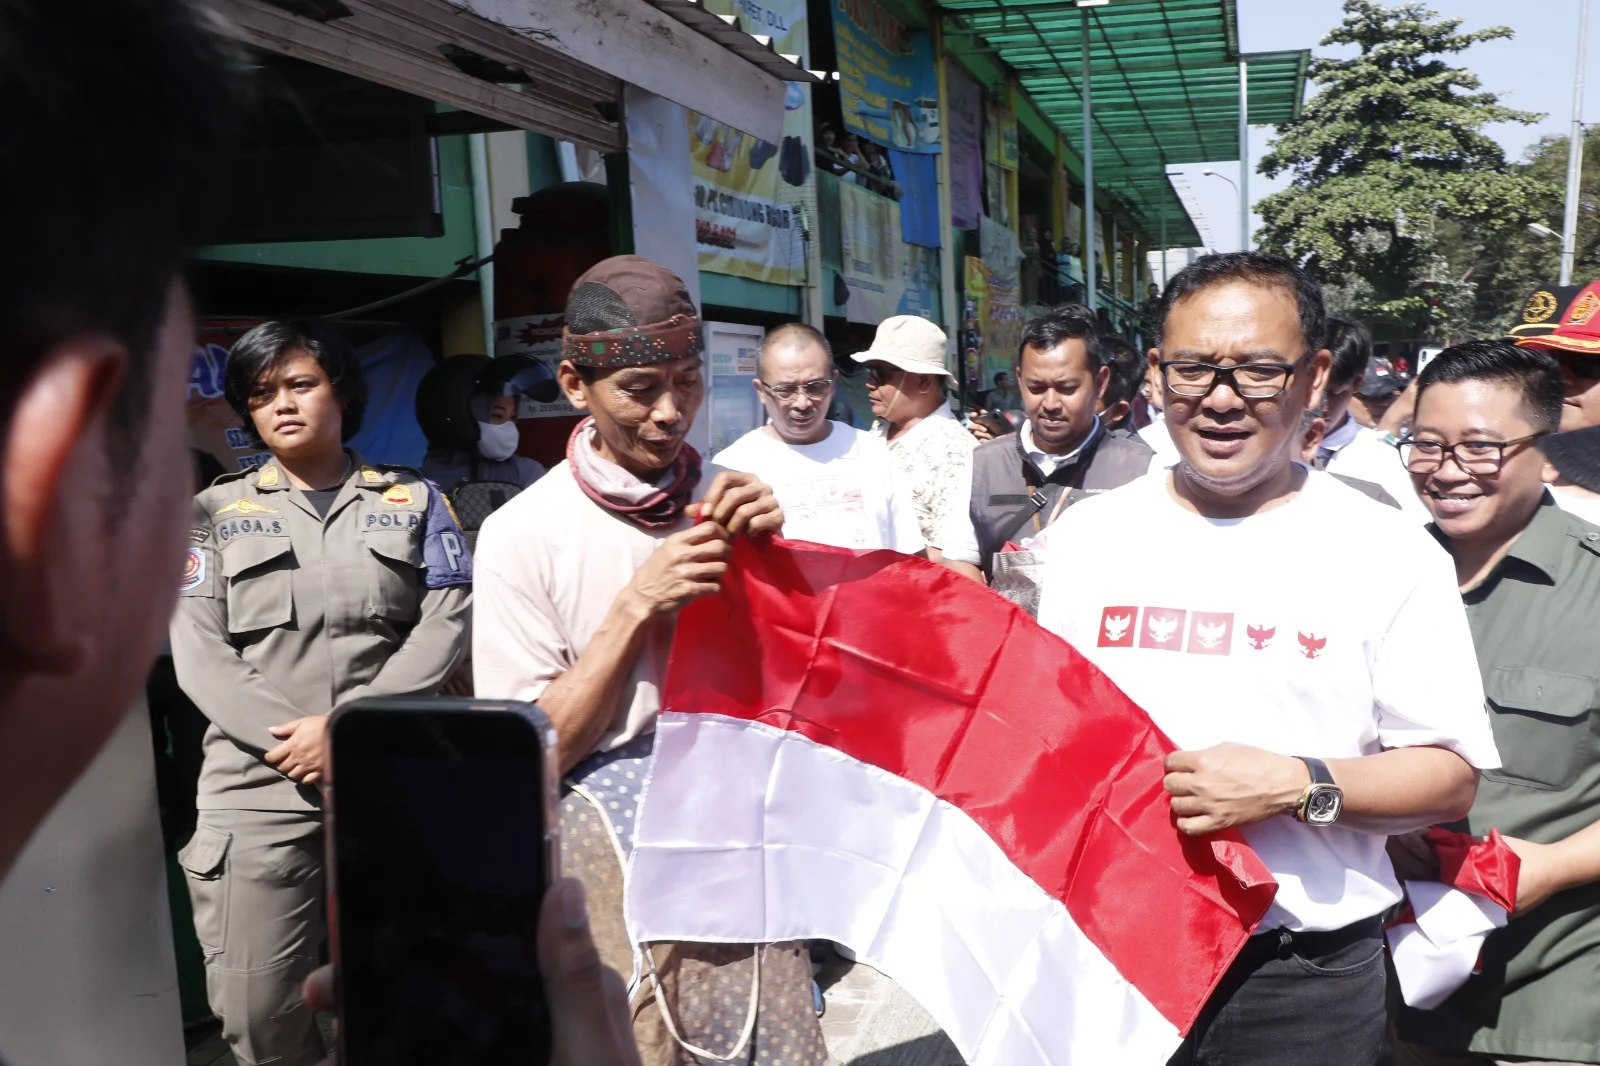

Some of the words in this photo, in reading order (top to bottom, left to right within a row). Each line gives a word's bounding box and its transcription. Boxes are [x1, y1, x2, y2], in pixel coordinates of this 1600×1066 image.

[766, 10, 788, 31] DLL
[220, 519, 282, 541] GAGA.S
[366, 513, 402, 528] POL
[440, 531, 463, 572] P
